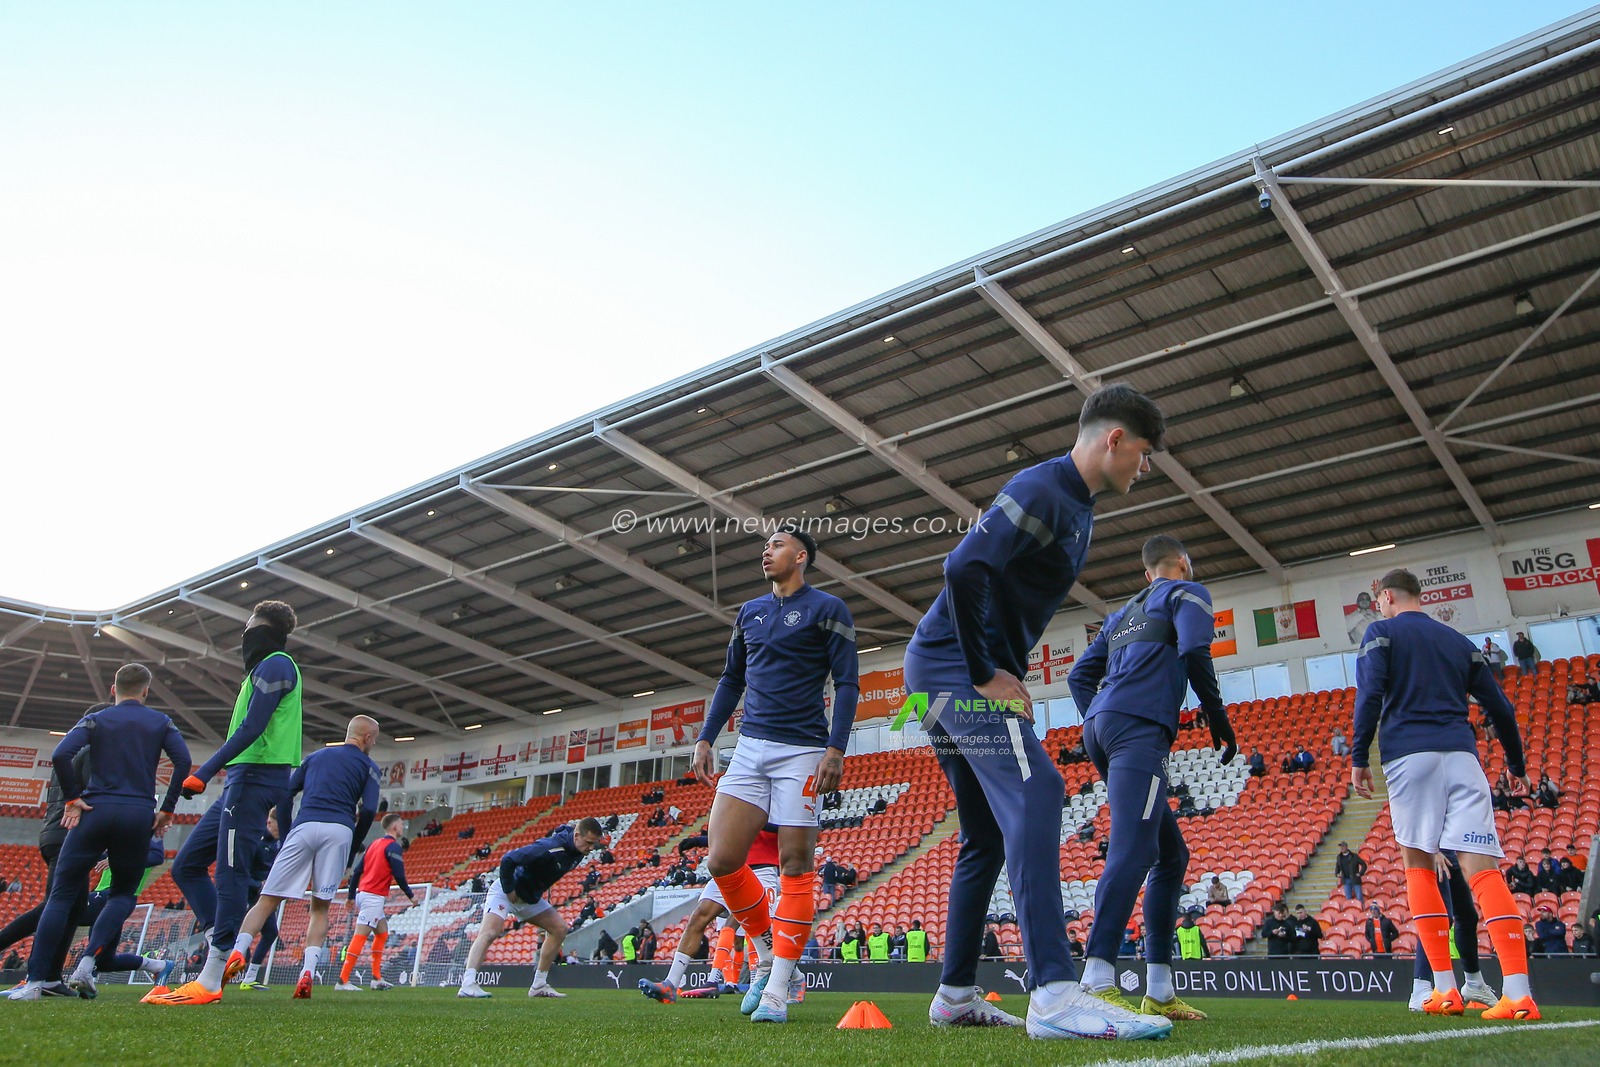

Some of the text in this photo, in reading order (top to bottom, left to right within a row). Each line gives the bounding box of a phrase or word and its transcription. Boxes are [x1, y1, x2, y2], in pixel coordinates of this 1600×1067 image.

[1532, 547, 1551, 556] THE
[1512, 552, 1576, 575] MSG
[1426, 565, 1449, 576] THE
[1451, 587, 1467, 598] FC
[1112, 622, 1147, 641] CATAPULT
[1052, 646, 1071, 656] DAVE
[1029, 658, 1065, 670] THE MIGHTY
[1055, 668, 1069, 677] BFC
[653, 711, 673, 721] SUPER
[1224, 970, 1311, 992] ONLINE
[1316, 970, 1394, 993] TODAY
